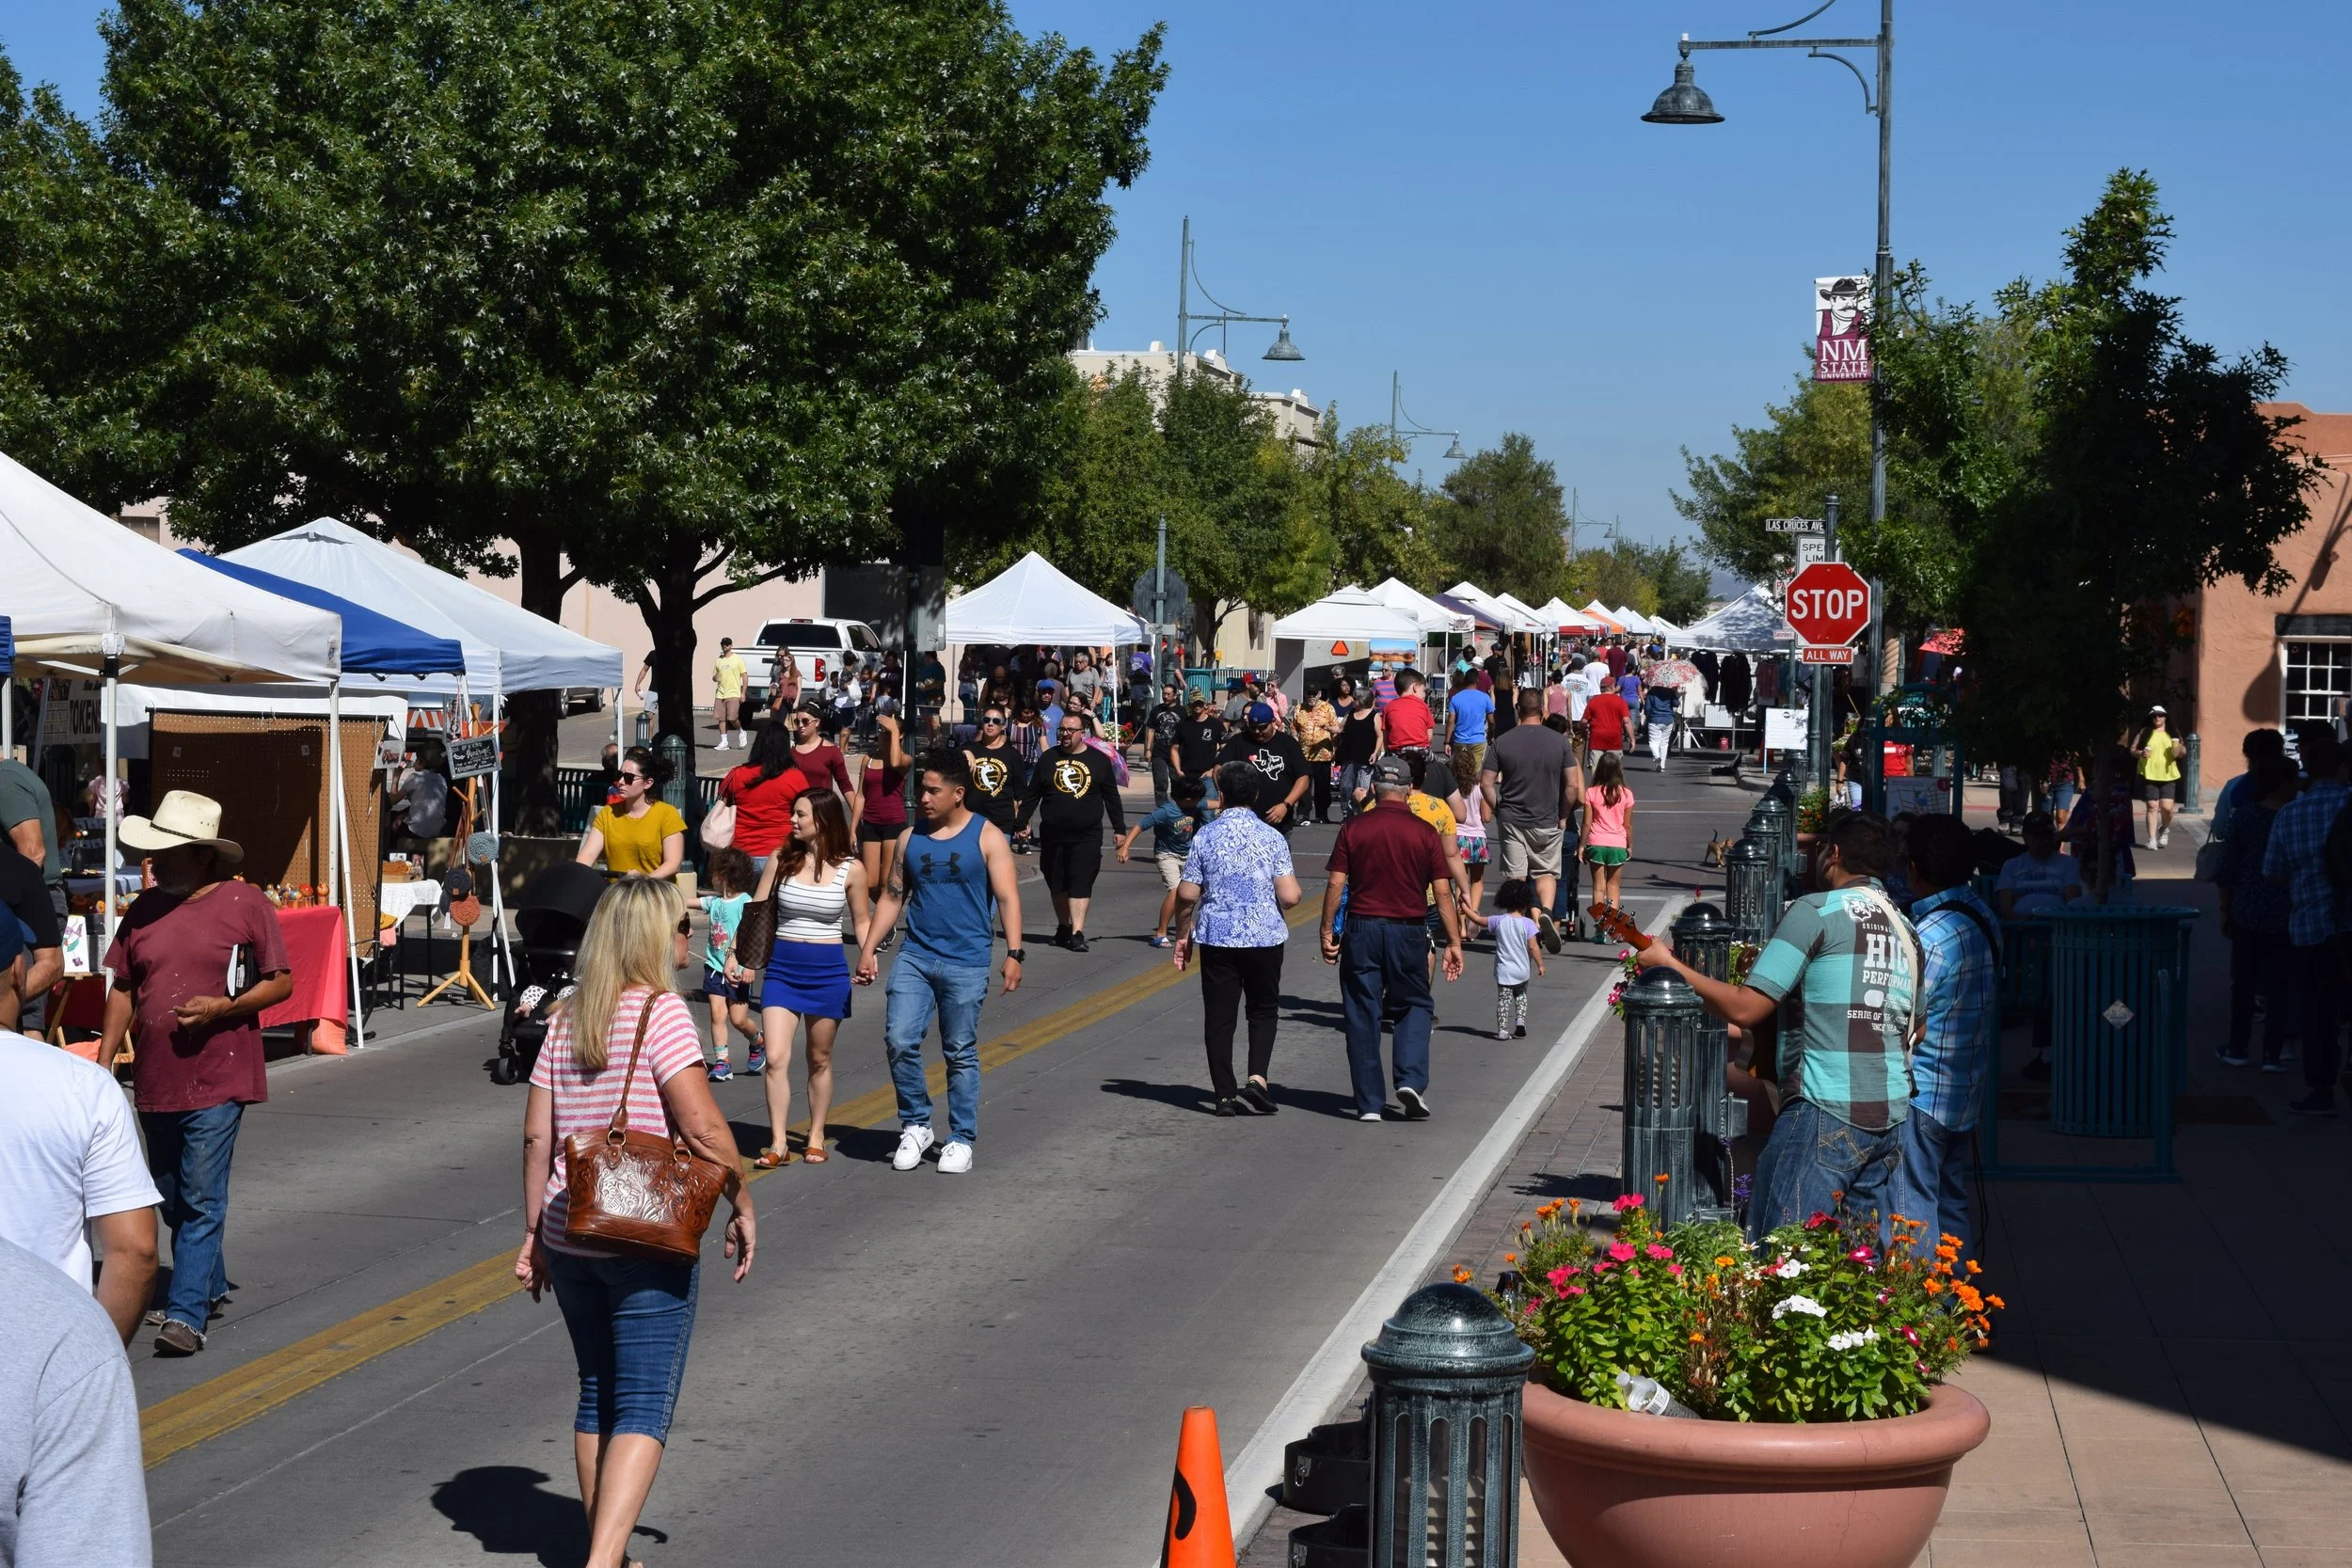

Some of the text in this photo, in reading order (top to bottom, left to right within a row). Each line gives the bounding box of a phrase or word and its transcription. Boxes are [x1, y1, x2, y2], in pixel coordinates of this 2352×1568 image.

[1821, 339, 1867, 361] NM
[1820, 361, 1868, 372] STATE
[1768, 520, 1824, 531] LAS CRUCES AVE
[1802, 543, 1823, 552] SPE
[1791, 589, 1864, 620] STOP
[1806, 650, 1849, 661] ALL WAY
[1862, 923, 1893, 933] ORIGINAL
[1864, 933, 1910, 974] HIG
[1847, 1009, 1872, 1020] SERIES
[1873, 1012, 1882, 1021] OF
